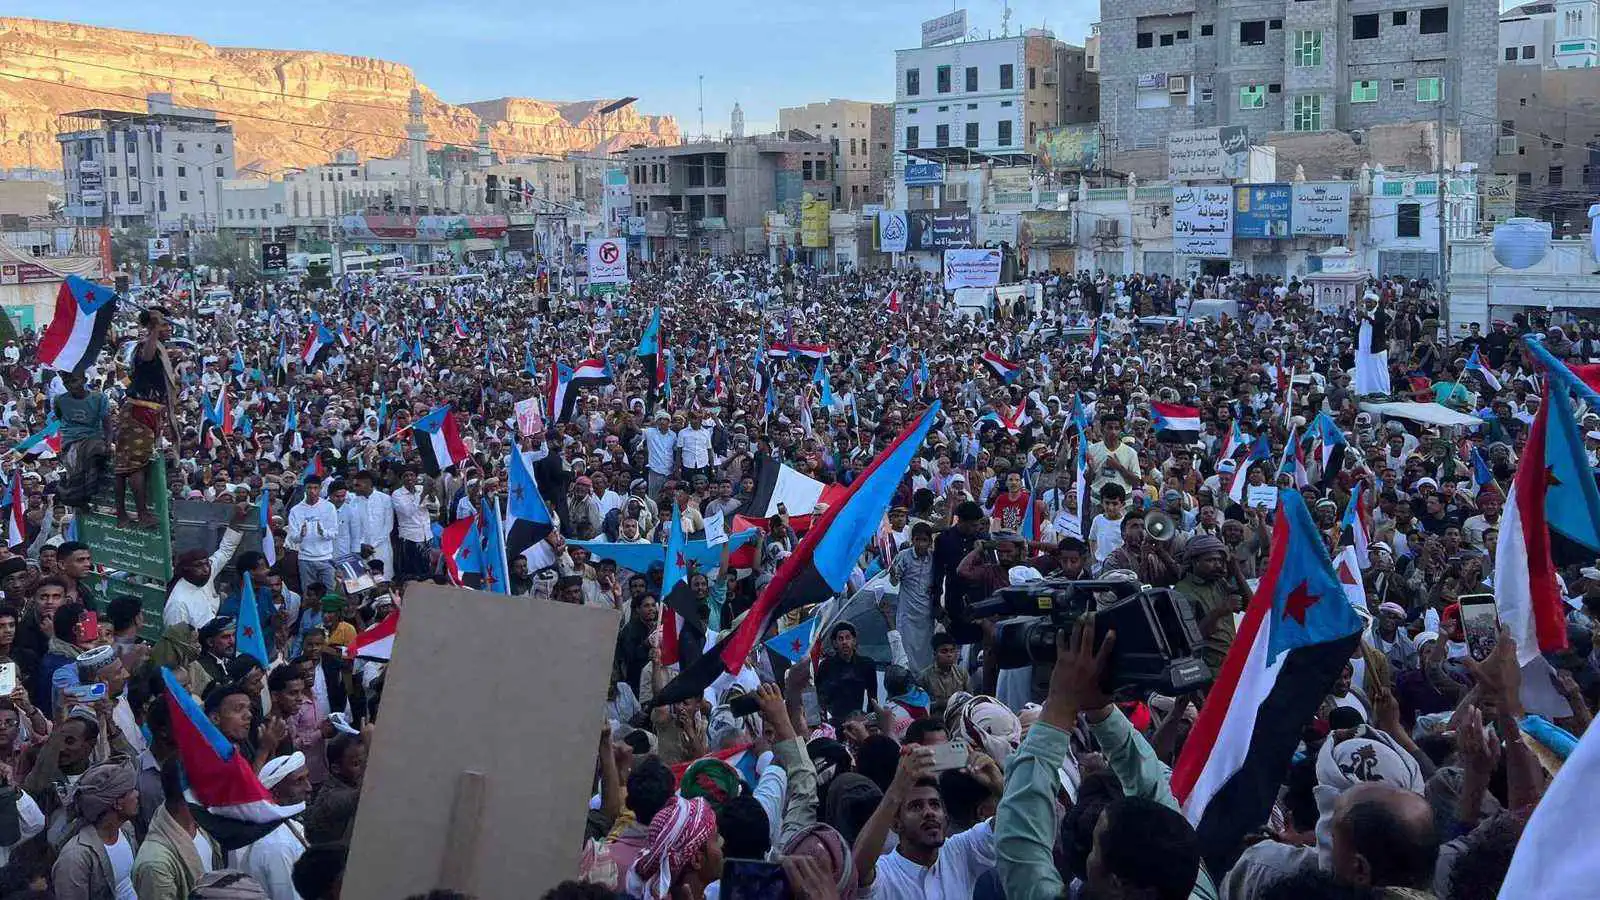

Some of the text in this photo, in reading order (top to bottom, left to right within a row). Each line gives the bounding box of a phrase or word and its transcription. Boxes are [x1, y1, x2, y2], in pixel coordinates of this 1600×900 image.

[1204, 189, 1228, 204] برمجة
[1198, 204, 1228, 220] وصيانة
[1176, 220, 1228, 236] الجوالات
